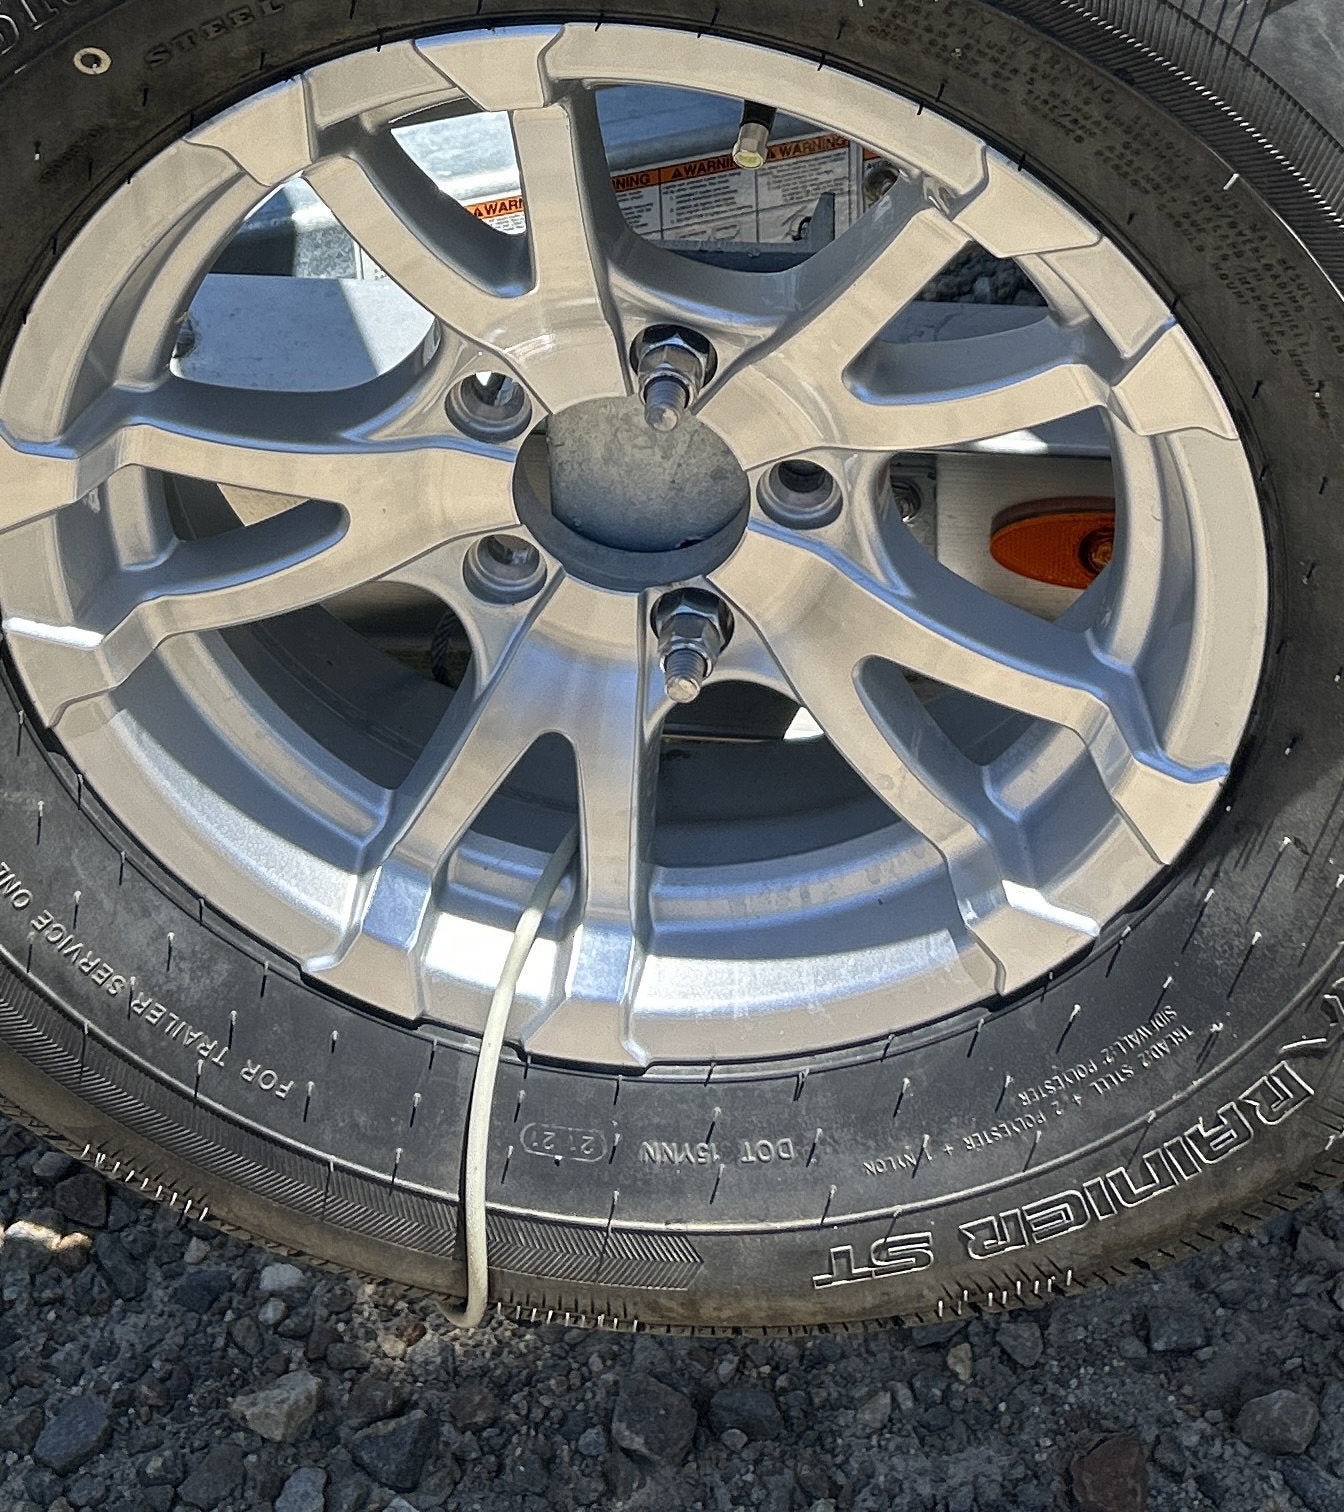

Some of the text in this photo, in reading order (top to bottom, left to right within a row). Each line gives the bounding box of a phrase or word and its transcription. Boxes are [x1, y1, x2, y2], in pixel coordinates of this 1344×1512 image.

[683, 157, 735, 177] WARNI
[778, 137, 849, 158] WARNING
[611, 173, 651, 189] NING
[26, 908, 131, 998] SERVICE
[123, 989, 235, 1069] TRAILER
[234, 1057, 296, 1101] FOR
[1013, 1057, 1101, 1107] POLYESTER
[1086, 1062, 1137, 1096] STEEL
[958, 1107, 1048, 1151] POLYESTER
[735, 1136, 797, 1164] DOT
[860, 1151, 919, 1177] NYLON
[811, 1231, 936, 1291] ST
